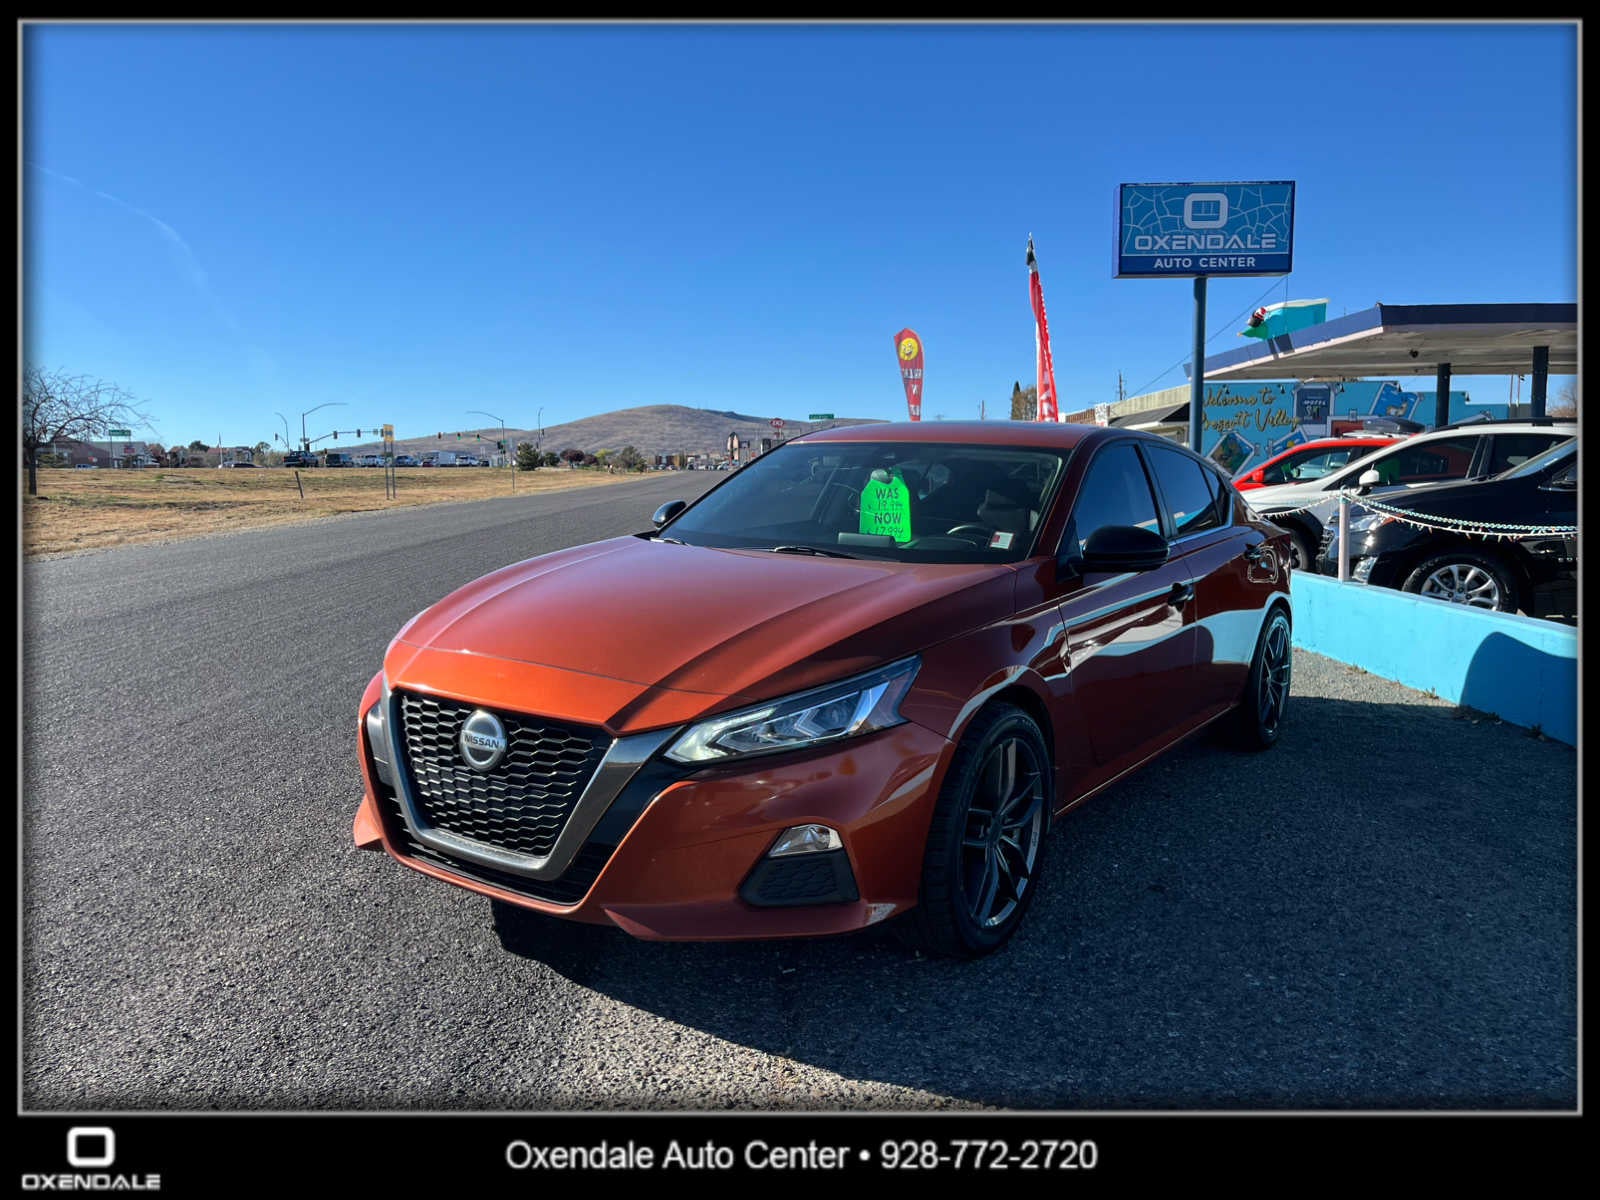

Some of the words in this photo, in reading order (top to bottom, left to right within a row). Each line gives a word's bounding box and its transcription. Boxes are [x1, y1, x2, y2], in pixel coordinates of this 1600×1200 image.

[1134, 233, 1276, 251] OXENDALE
[1154, 257, 1193, 269] AUTO
[1198, 256, 1256, 268] CENTER
[1258, 386, 1277, 406] to
[875, 487, 900, 500] WAS
[874, 511, 902, 525] NOW
[464, 734, 500, 749] NISSAN
